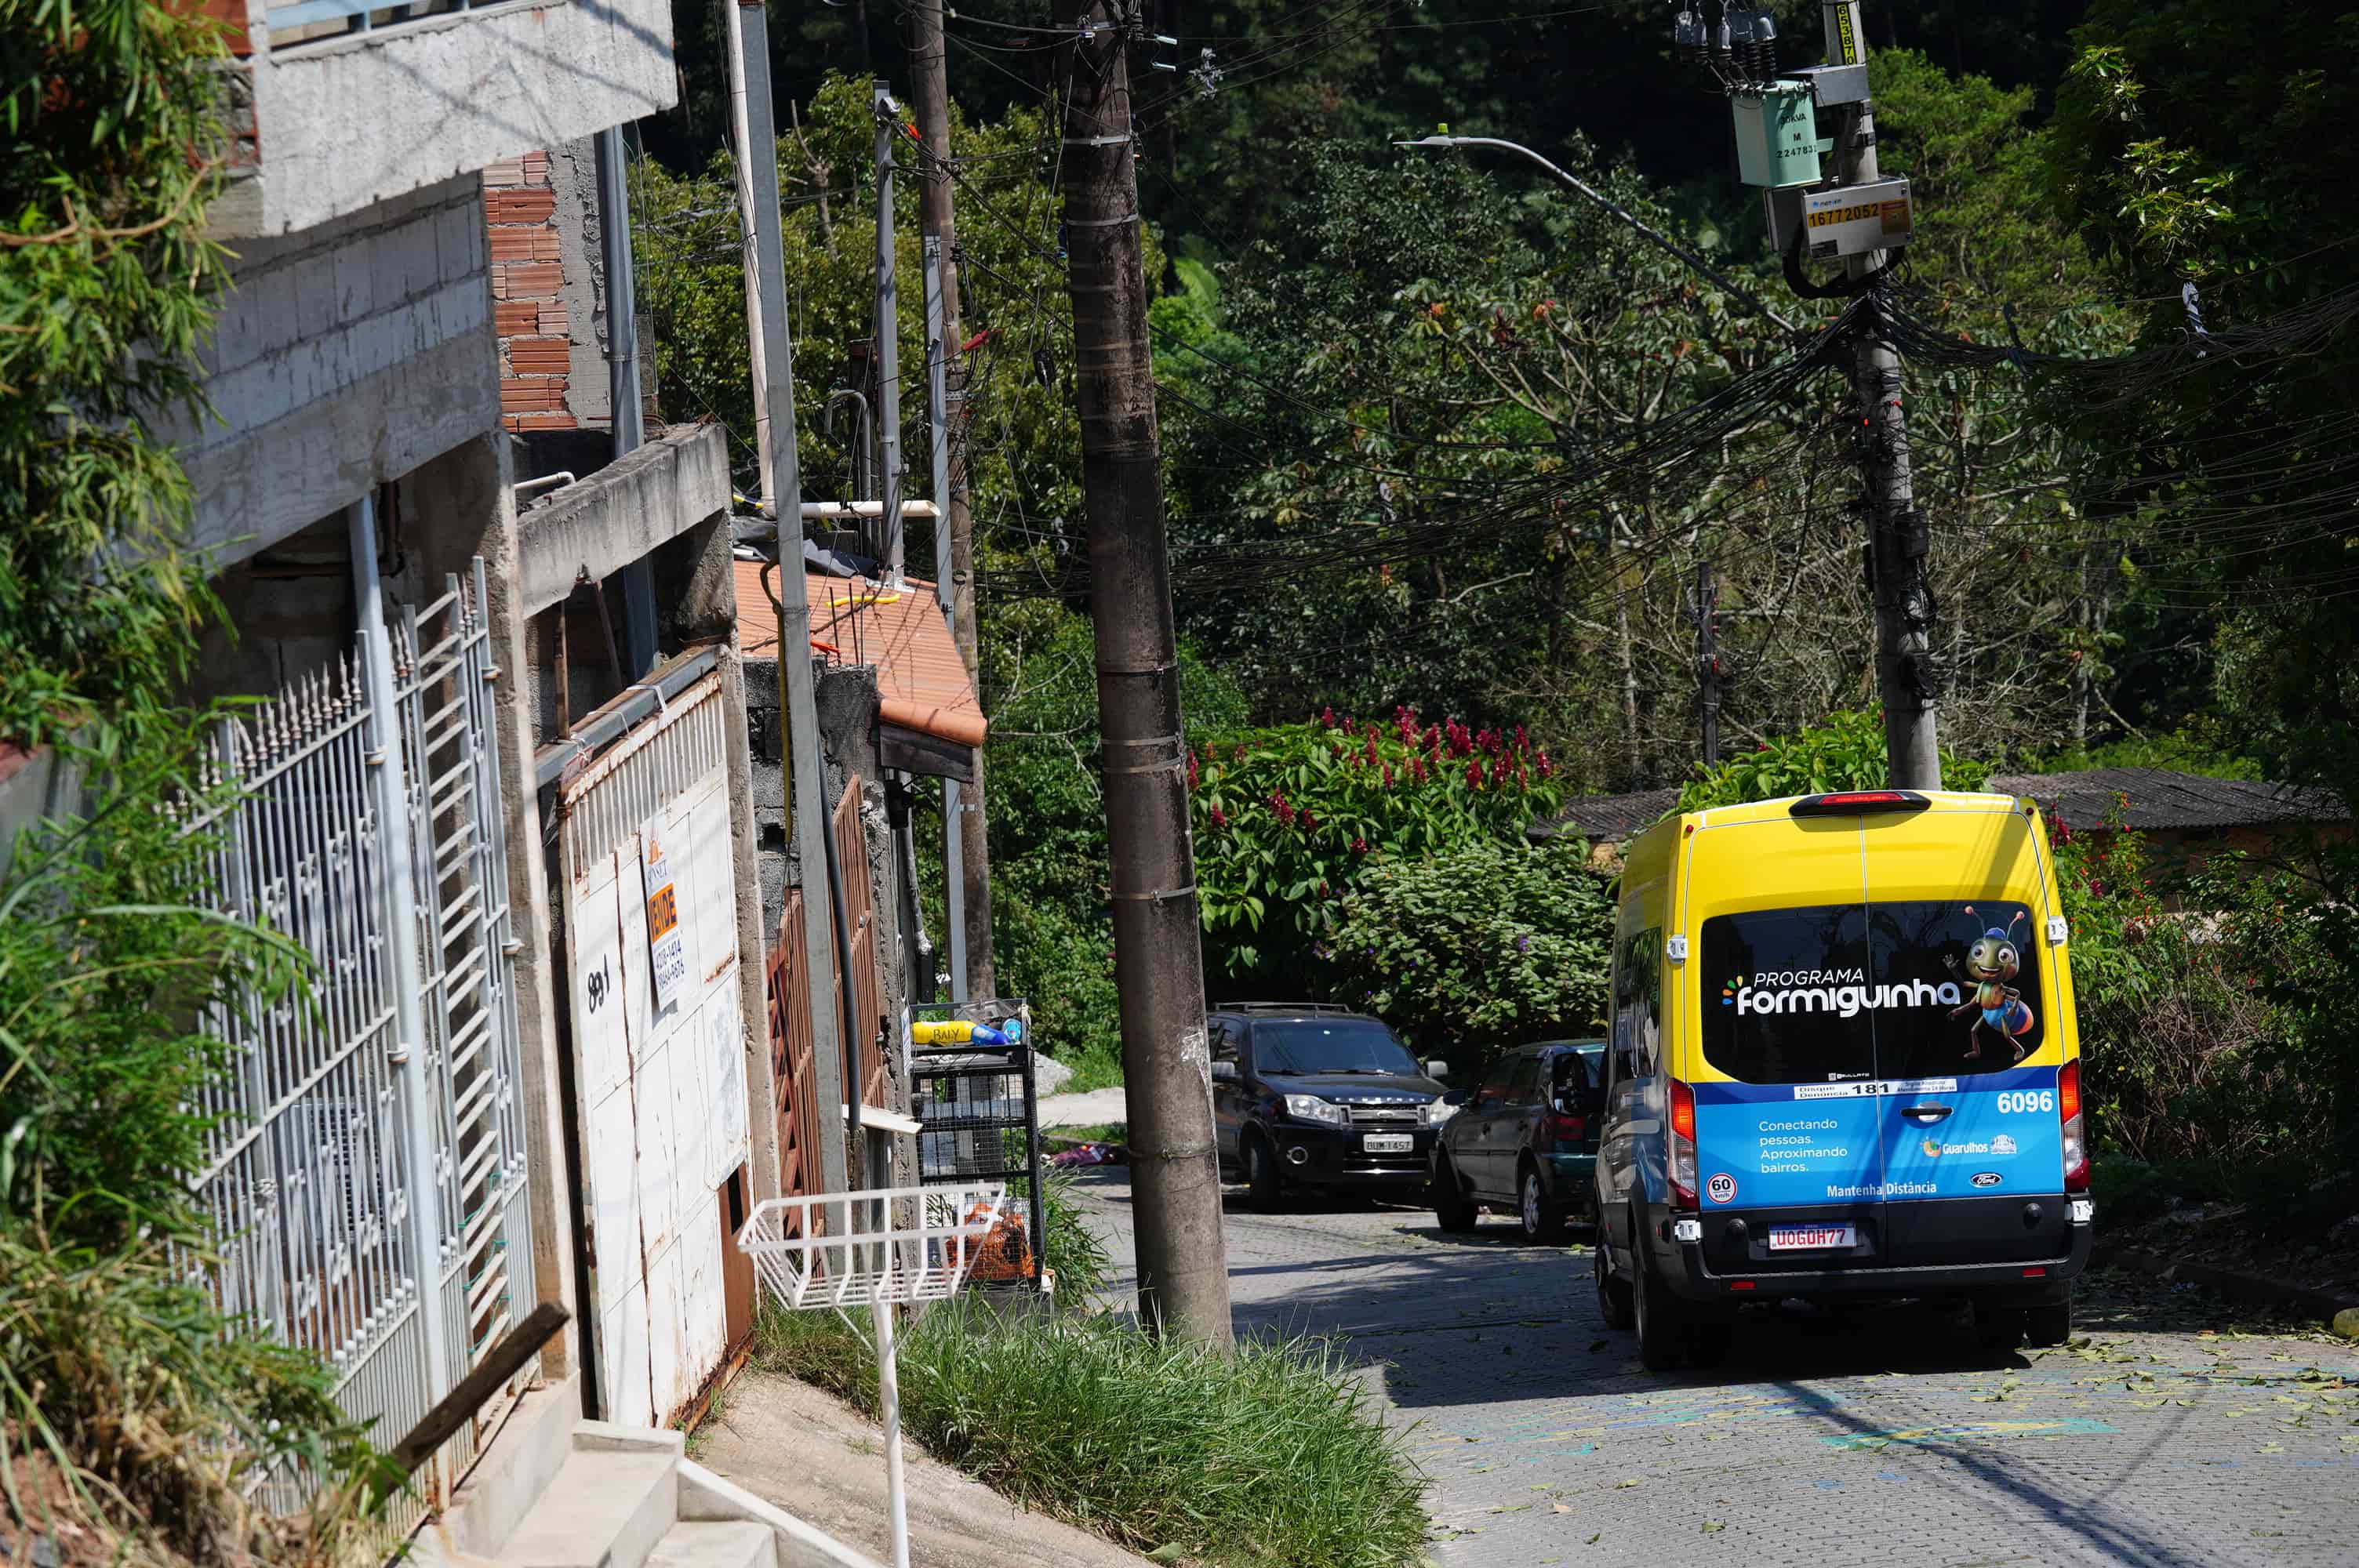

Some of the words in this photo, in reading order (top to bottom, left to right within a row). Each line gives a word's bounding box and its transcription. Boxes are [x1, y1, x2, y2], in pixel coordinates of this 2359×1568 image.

[1839, 6, 1854, 64] 653870
[1810, 203, 1879, 227] 16772052
[1754, 968, 1864, 987] PROGRAMA
[1737, 978, 1961, 1018] formiguinha
[1852, 1083, 1888, 1094] 181
[1997, 1091, 2053, 1113] 6096
[1759, 1119, 1837, 1131] Conectando
[1760, 1135, 1814, 1147] pessoas.
[1943, 1142, 1988, 1154] Guarulhos
[1761, 1146, 1848, 1160] Aproximando
[1761, 1163, 1808, 1174] bairros.
[1712, 1178, 1731, 1191] 60
[1826, 1184, 1882, 1197] Mantenha
[1886, 1181, 1937, 1195] Distância
